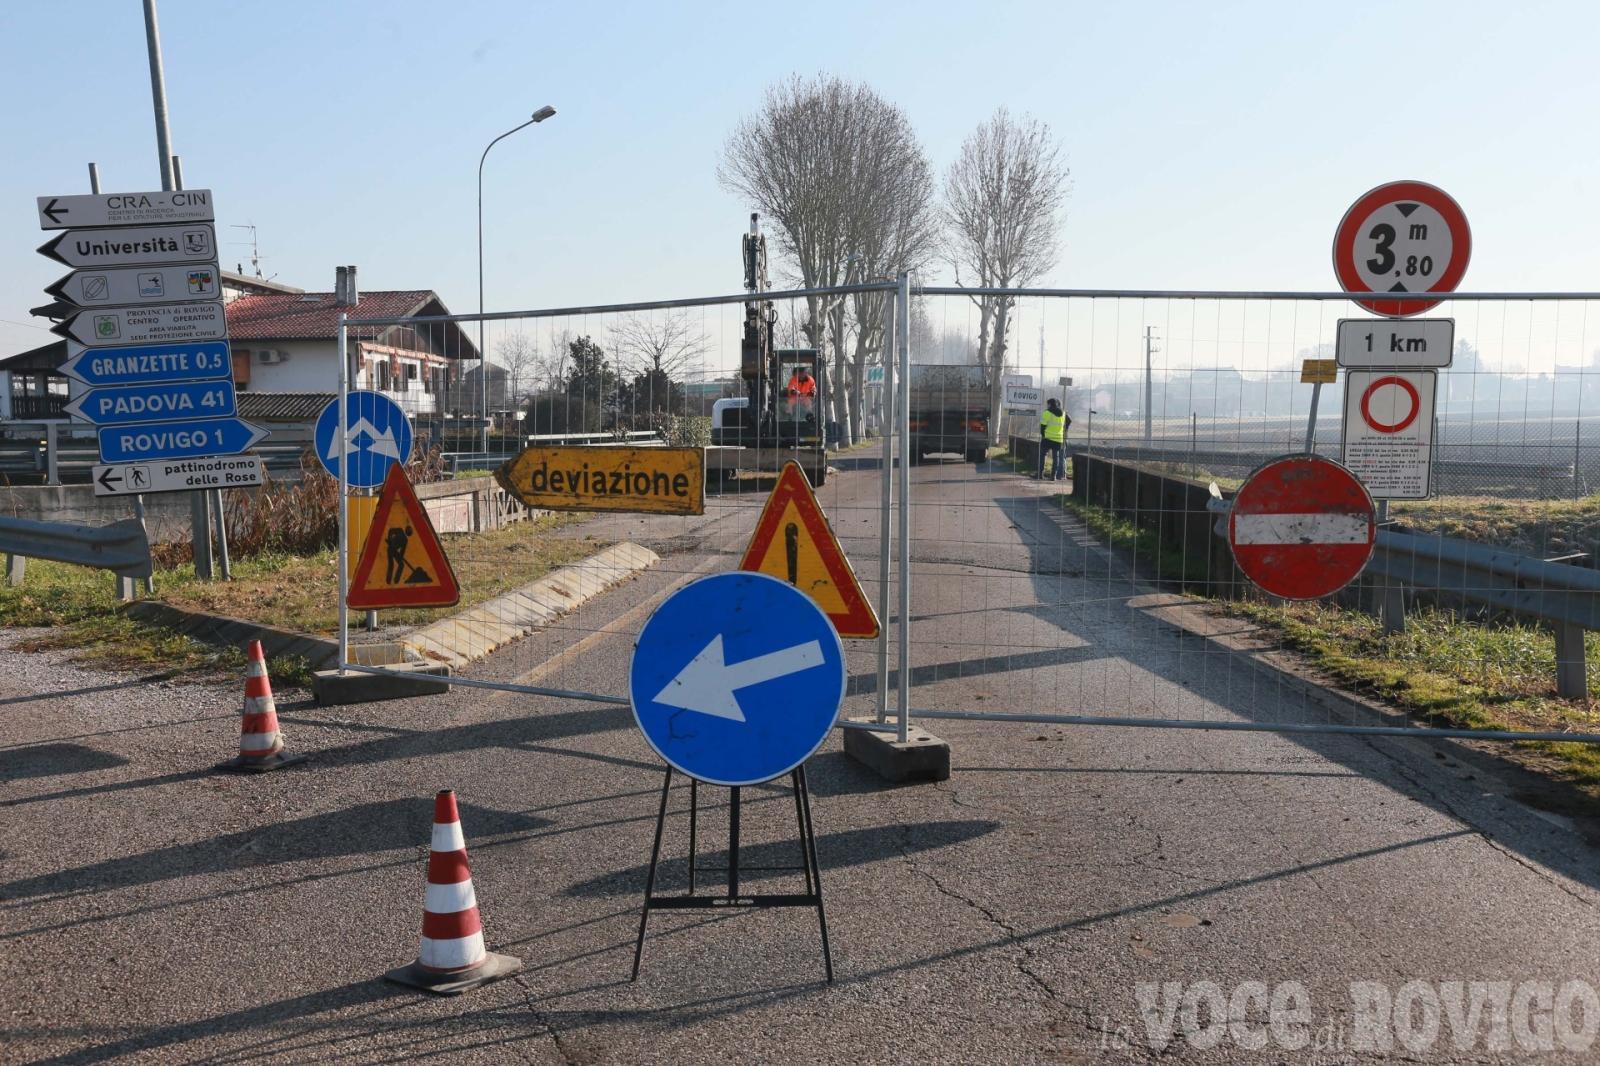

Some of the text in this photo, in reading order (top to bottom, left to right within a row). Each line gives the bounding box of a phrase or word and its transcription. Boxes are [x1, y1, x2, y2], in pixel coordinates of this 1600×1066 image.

[107, 195, 152, 209] CRA
[171, 193, 206, 206] CIN
[76, 237, 179, 257] Università
[127, 308, 172, 317] PROVINCIA
[183, 306, 215, 314] ROVIGO
[127, 314, 215, 325] CENTRO OPERATIVO
[149, 332, 193, 340] PROTEZIONE
[1364, 332, 1428, 353] 1 km
[92, 352, 222, 376] GRANZETTE 0.5
[99, 390, 225, 415] PADOVA 41
[121, 429, 224, 453] ROVIGO 1
[164, 460, 255, 477] pattinodromo
[186, 472, 257, 486] delle Rose
[531, 462, 689, 498] deviazione
